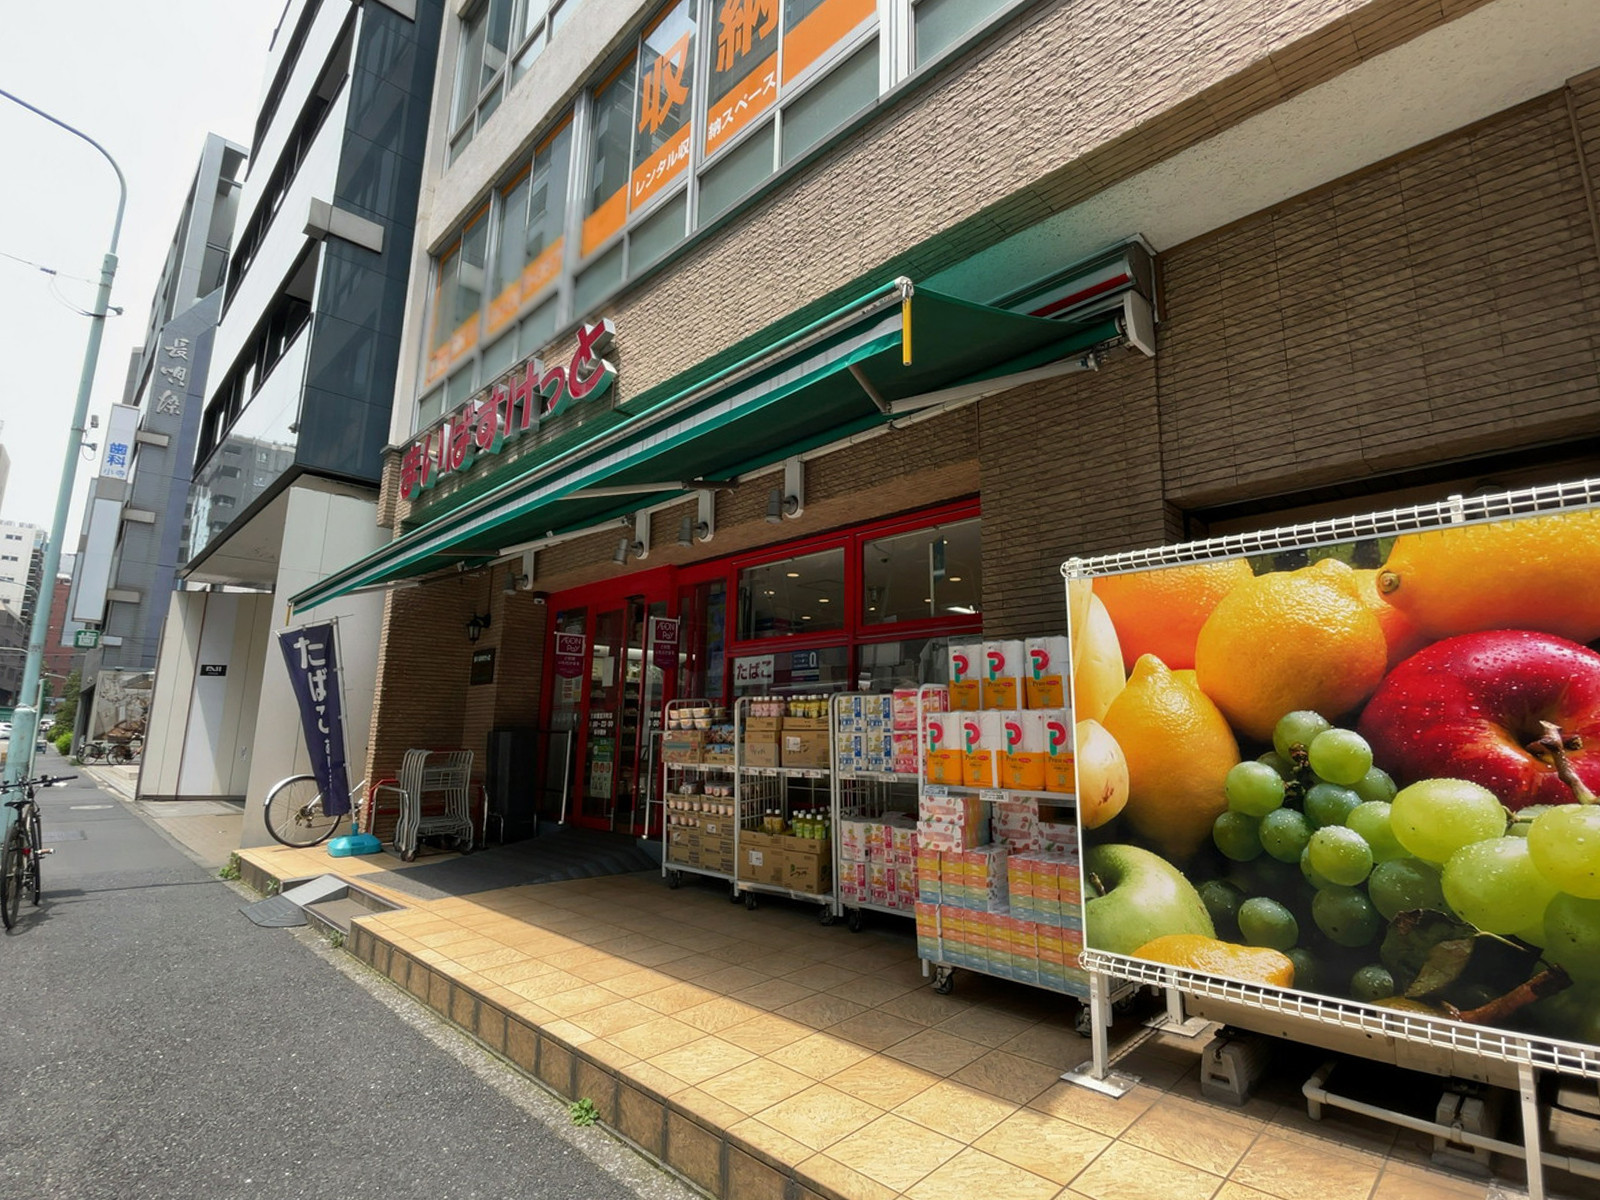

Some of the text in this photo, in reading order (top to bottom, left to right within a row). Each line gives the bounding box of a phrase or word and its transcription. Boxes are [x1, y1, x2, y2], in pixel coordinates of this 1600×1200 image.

[401, 318, 615, 499] まいばすけっと
[107, 442, 128, 468] 歯科
[737, 660, 772, 680] たばこ
